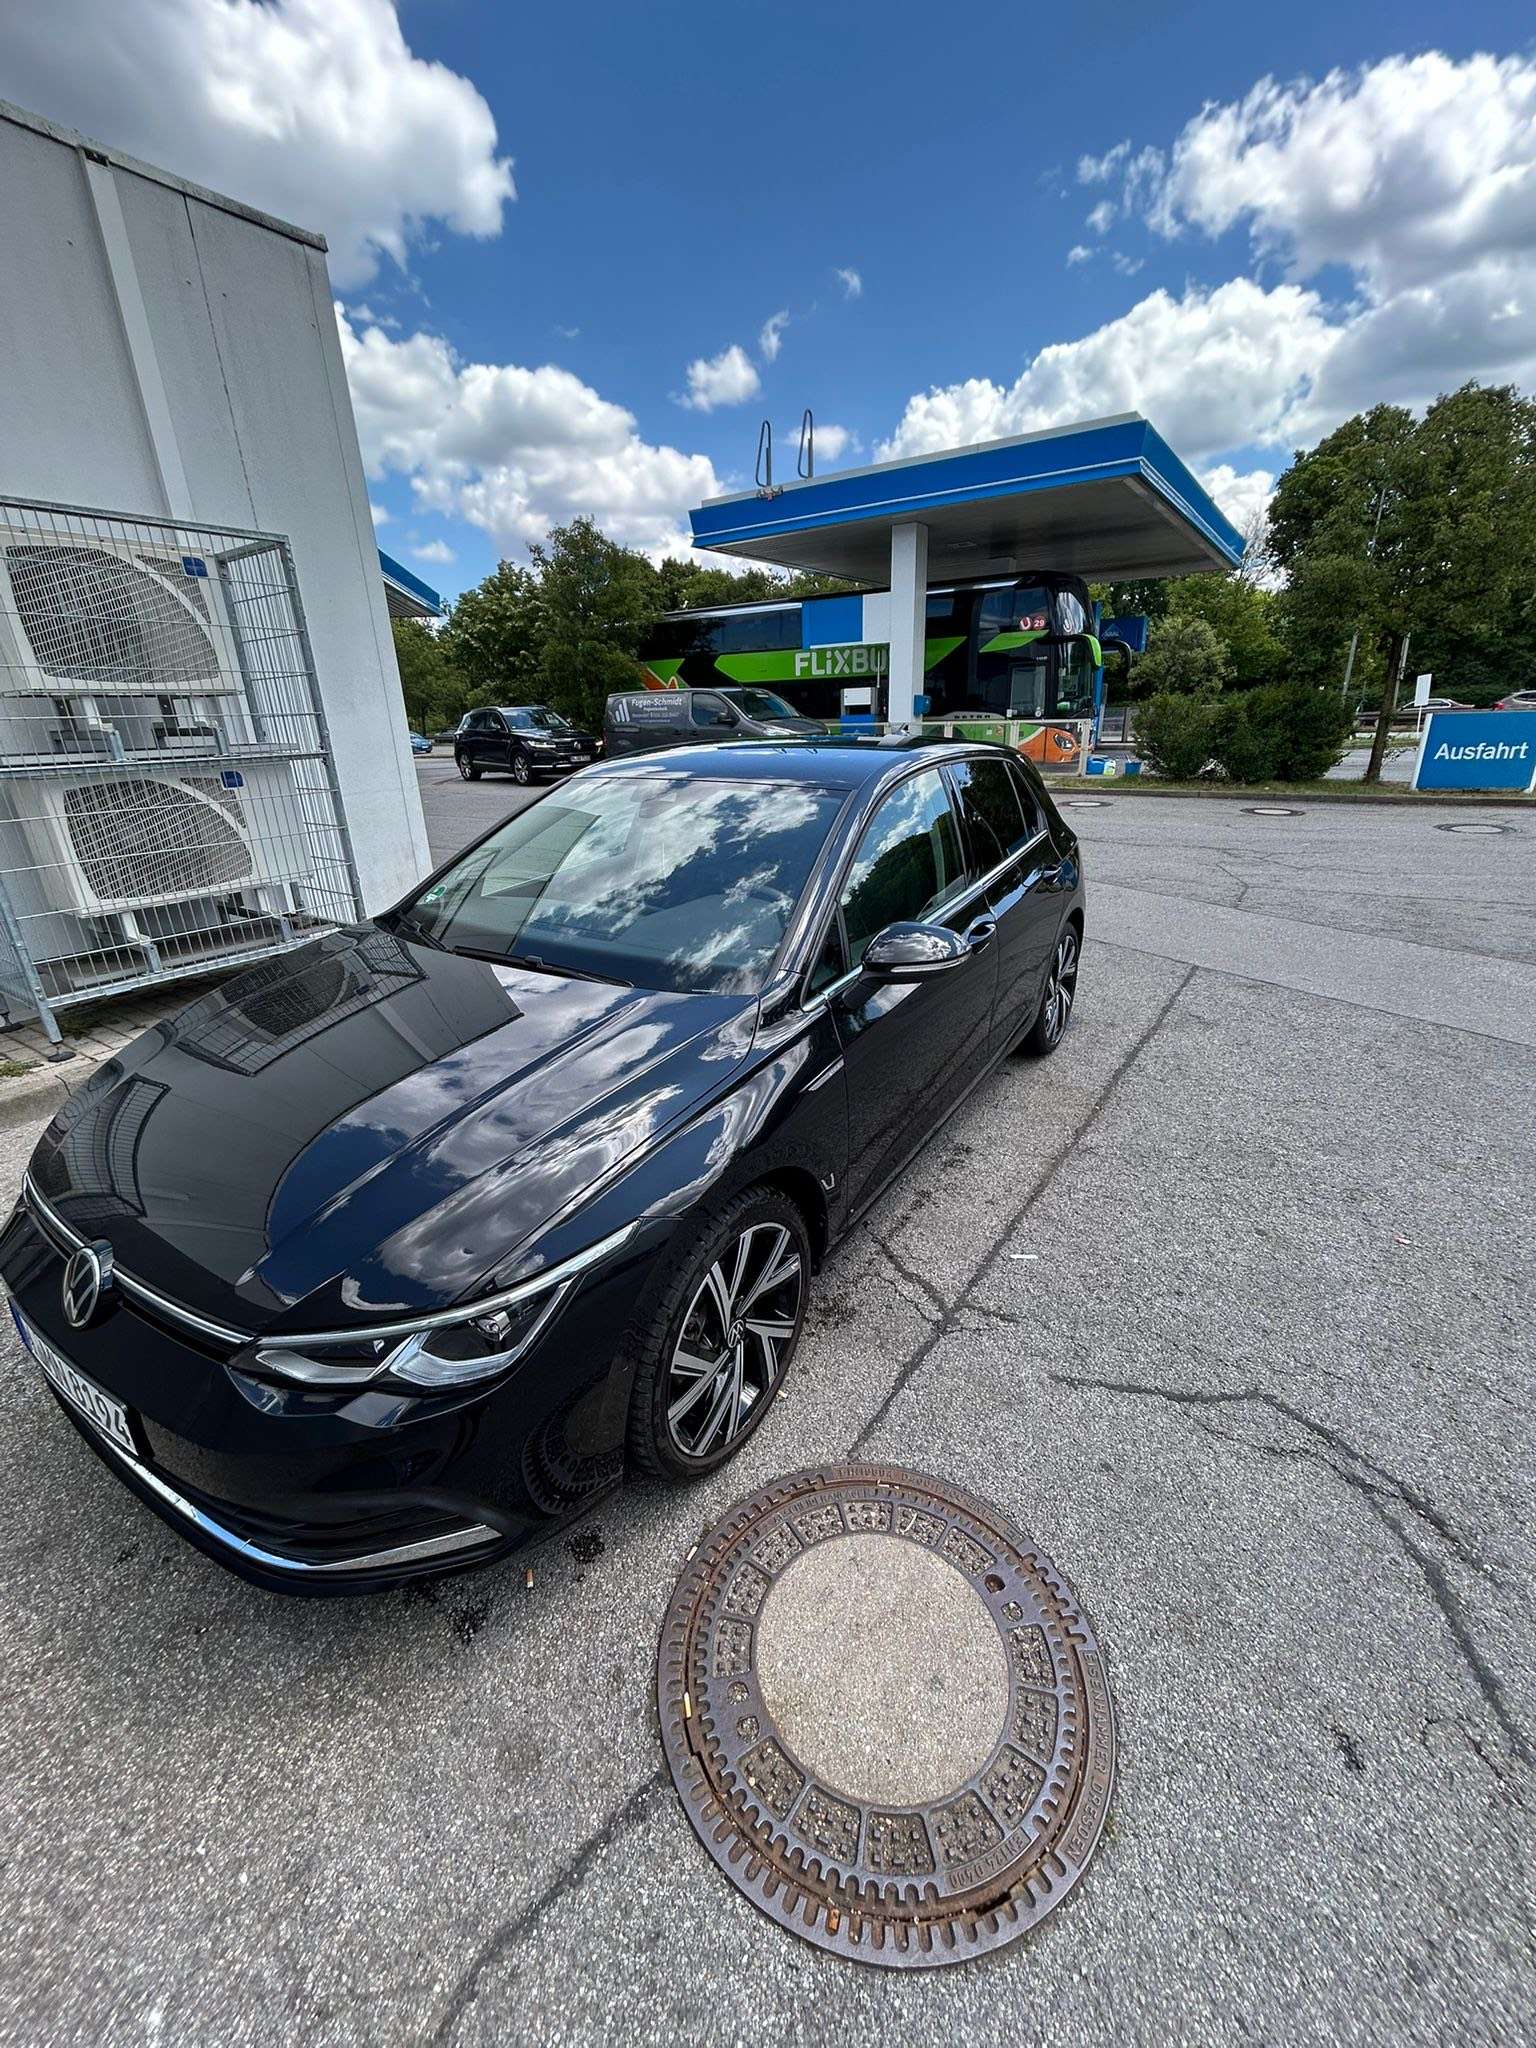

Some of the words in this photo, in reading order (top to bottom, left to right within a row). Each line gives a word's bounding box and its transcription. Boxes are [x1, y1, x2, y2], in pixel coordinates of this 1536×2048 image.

[1433, 741, 1529, 760] Ausfahrt
[1083, 1652, 1111, 1776] EISENHAMMER
[1067, 1782, 1105, 1863] DRESDEN
